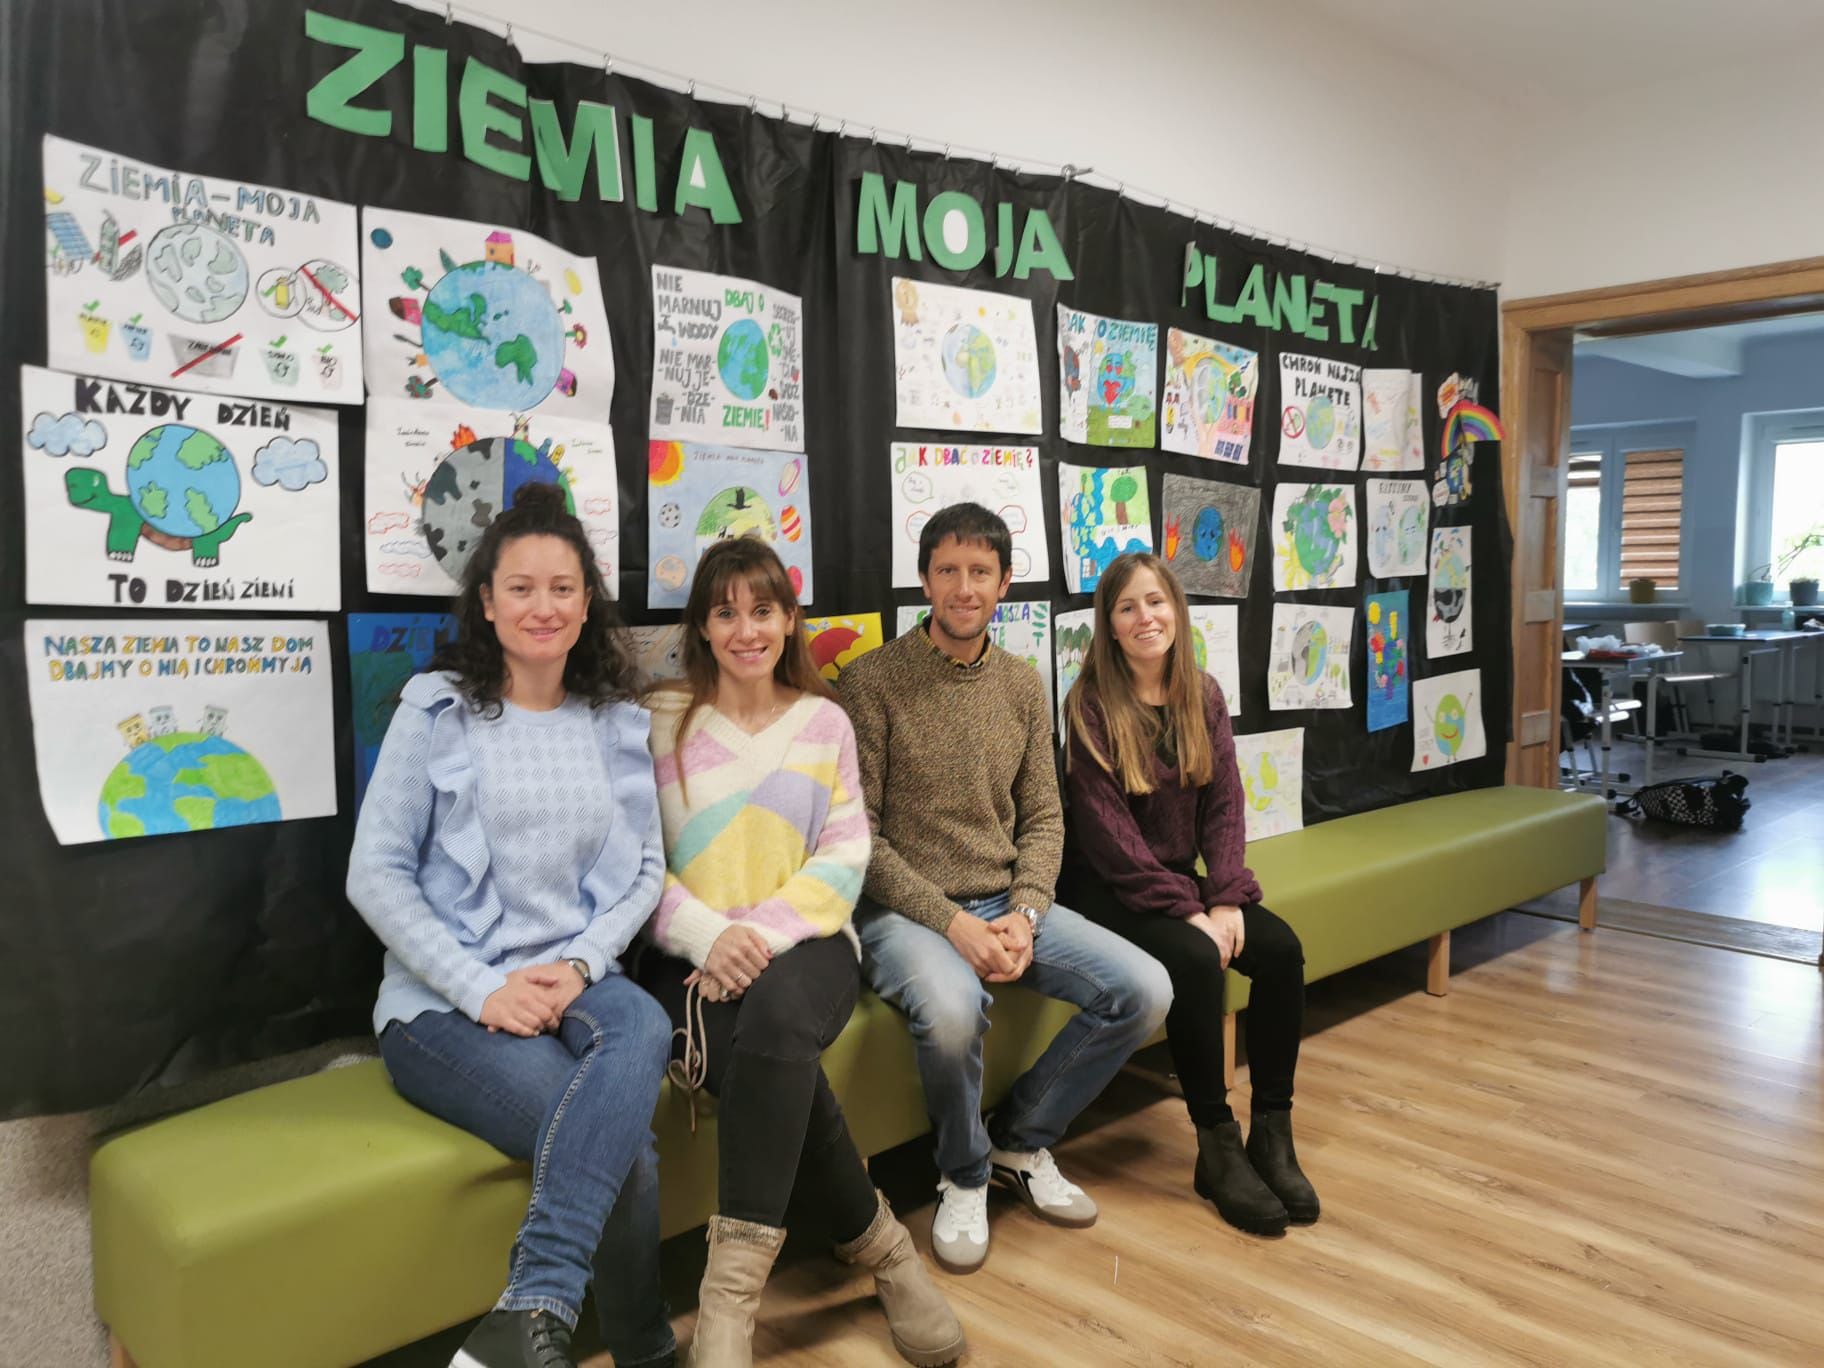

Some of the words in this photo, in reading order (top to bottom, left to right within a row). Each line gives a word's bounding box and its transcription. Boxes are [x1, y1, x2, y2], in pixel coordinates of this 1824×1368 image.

[305, 10, 742, 224] ZIEMIA
[857, 171, 1075, 280] MOJA
[80, 153, 208, 208] ZIEMIA
[236, 186, 320, 224] MOJA
[171, 205, 275, 247] PLANETA
[656, 272, 683, 293] NIE
[658, 294, 722, 321] MARNUJ
[724, 288, 754, 315] DBAJ
[758, 294, 765, 313] O
[678, 322, 719, 340] WODY
[1097, 319, 1107, 338] O
[659, 349, 683, 367] NIE
[934, 445, 968, 466] DBAĆ
[108, 573, 147, 604] TO
[165, 579, 235, 603] DZIEŃ
[240, 577, 295, 600] ZIEMI
[44, 635, 116, 657] NASZA
[122, 635, 178, 655] ZIEMIA
[186, 635, 211, 654] TO
[215, 636, 264, 654] NASZ
[271, 637, 313, 653] DOM
[50, 660, 133, 682] DBAJMY
[139, 661, 153, 677] O
